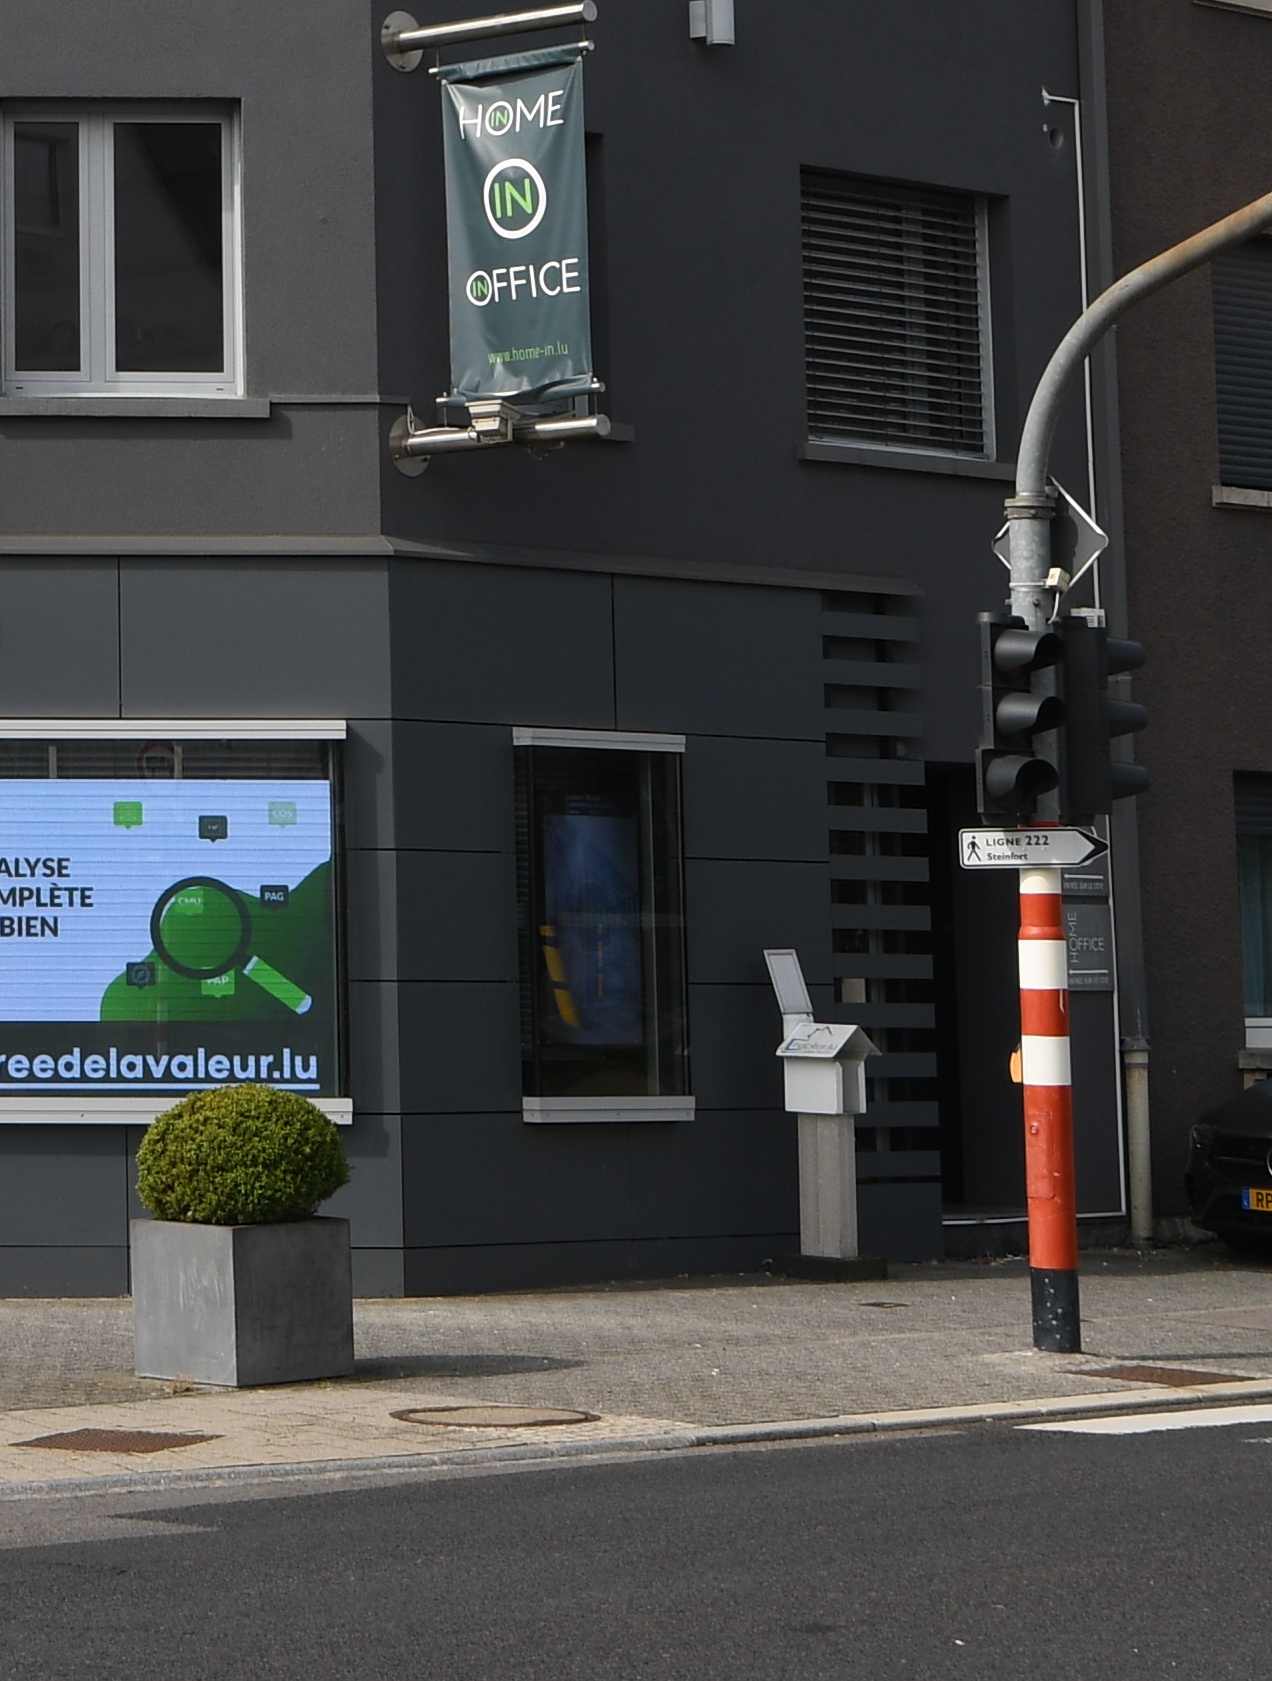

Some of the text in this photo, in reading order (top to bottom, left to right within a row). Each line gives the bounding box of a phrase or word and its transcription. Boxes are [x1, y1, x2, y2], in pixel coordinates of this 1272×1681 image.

[458, 89, 564, 140] HOME
[492, 177, 533, 219] IN
[466, 257, 582, 307] OFFICE
[487, 340, 569, 364] www.home-in.lu
[986, 835, 1049, 846] LIGNE 222
[987, 851, 1028, 861] Steinfort
[264, 891, 285, 902] PAG
[0, 916, 59, 938] BIEN
